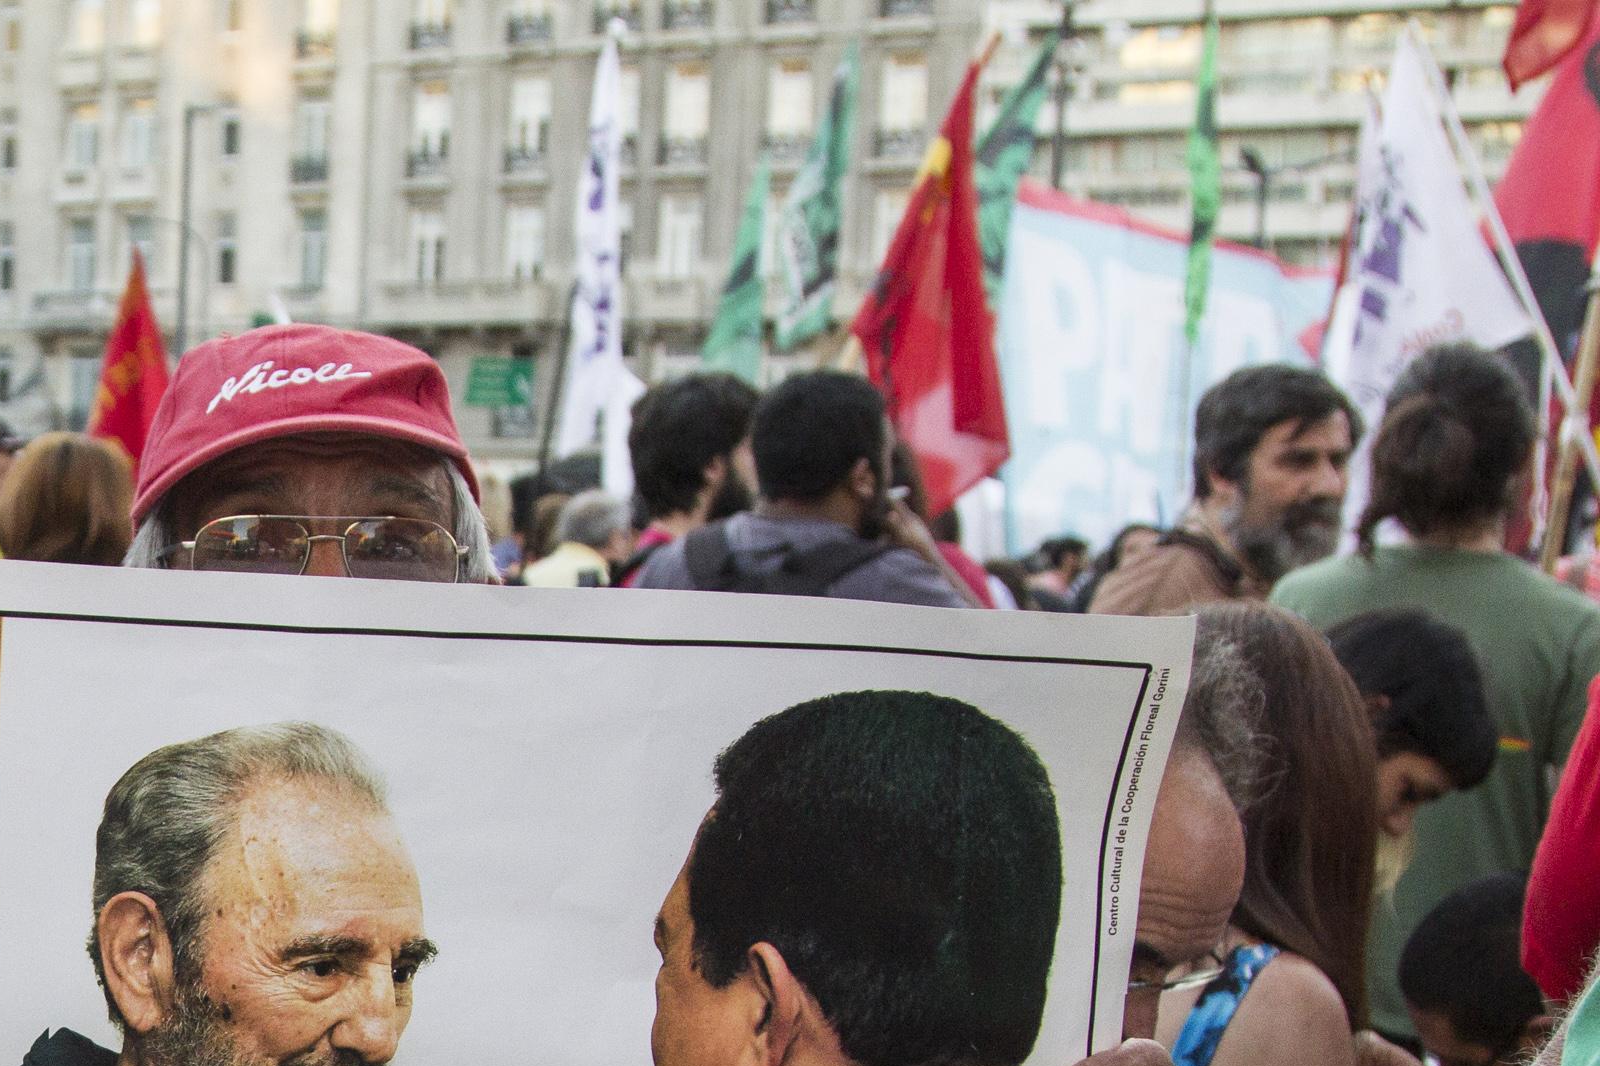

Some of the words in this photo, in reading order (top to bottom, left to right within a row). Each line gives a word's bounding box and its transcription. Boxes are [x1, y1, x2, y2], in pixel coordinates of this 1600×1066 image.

[1152, 667, 1171, 702] Gorini
[1140, 703, 1161, 741] Floreal
[1121, 742, 1150, 813] Cooperación
[1115, 828, 1128, 844] de
[1118, 815, 1130, 827] la
[1110, 846, 1125, 894] Cultural
[1108, 896, 1120, 937] Centro
